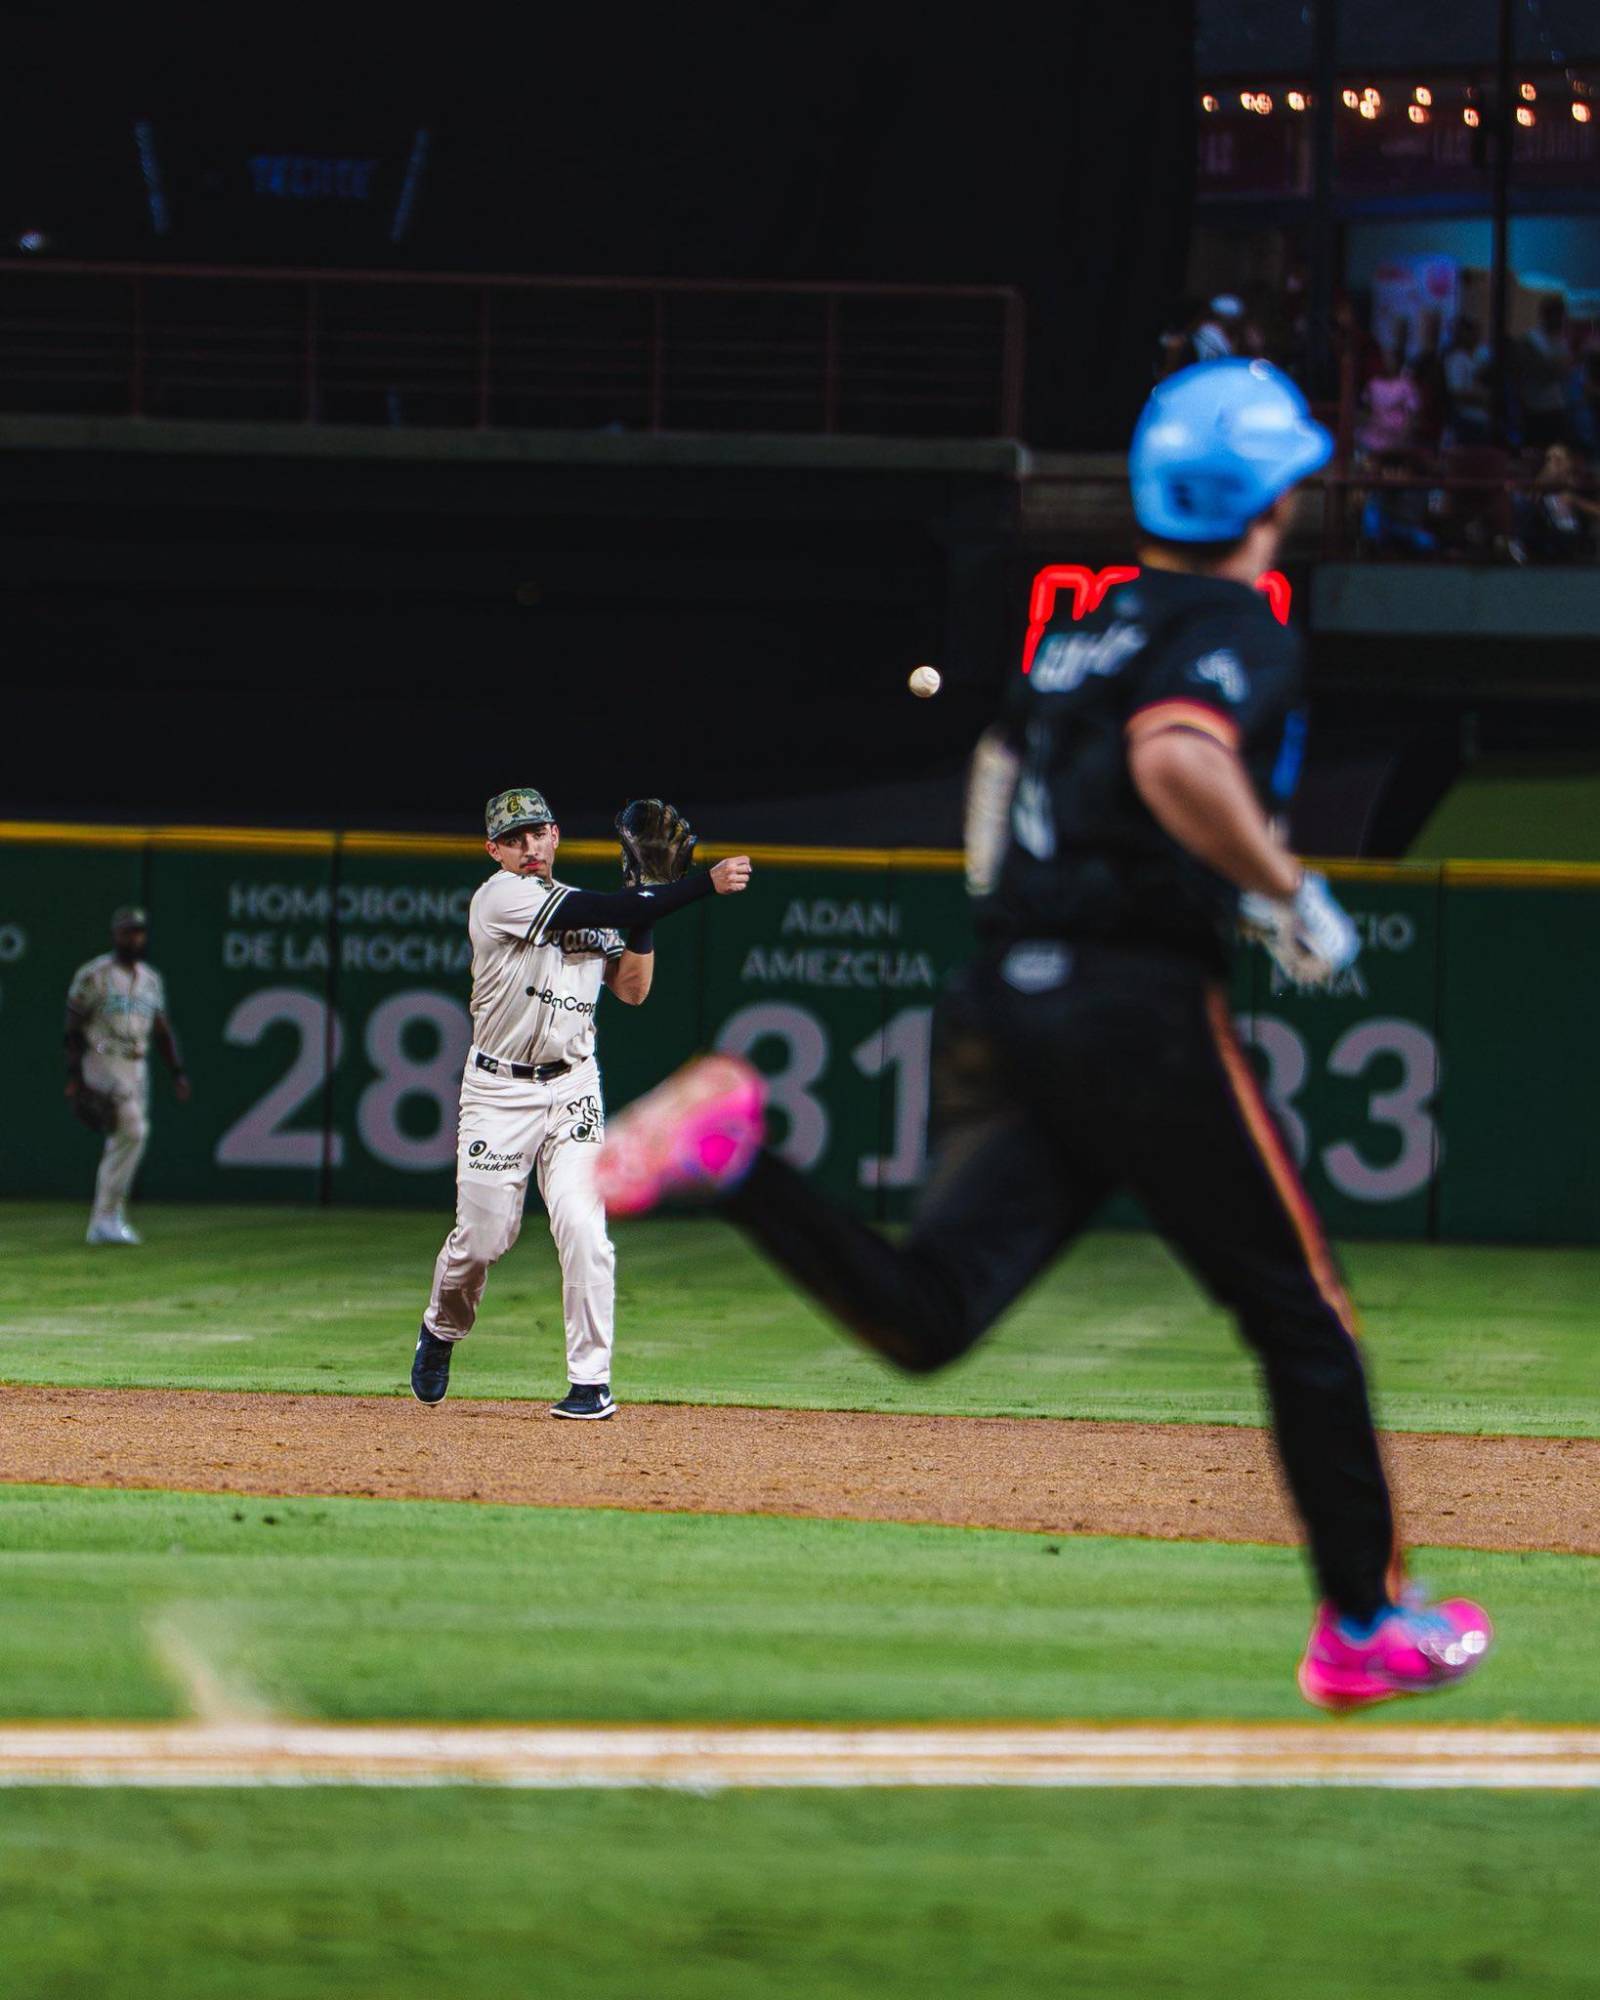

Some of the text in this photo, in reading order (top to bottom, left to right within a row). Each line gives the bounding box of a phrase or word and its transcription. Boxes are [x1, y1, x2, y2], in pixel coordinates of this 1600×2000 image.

[782, 902, 900, 936] ADAN
[223, 931, 472, 972] DE LA ROCHA
[740, 949, 935, 988] AMEZCUA
[216, 986, 473, 1170] 28
